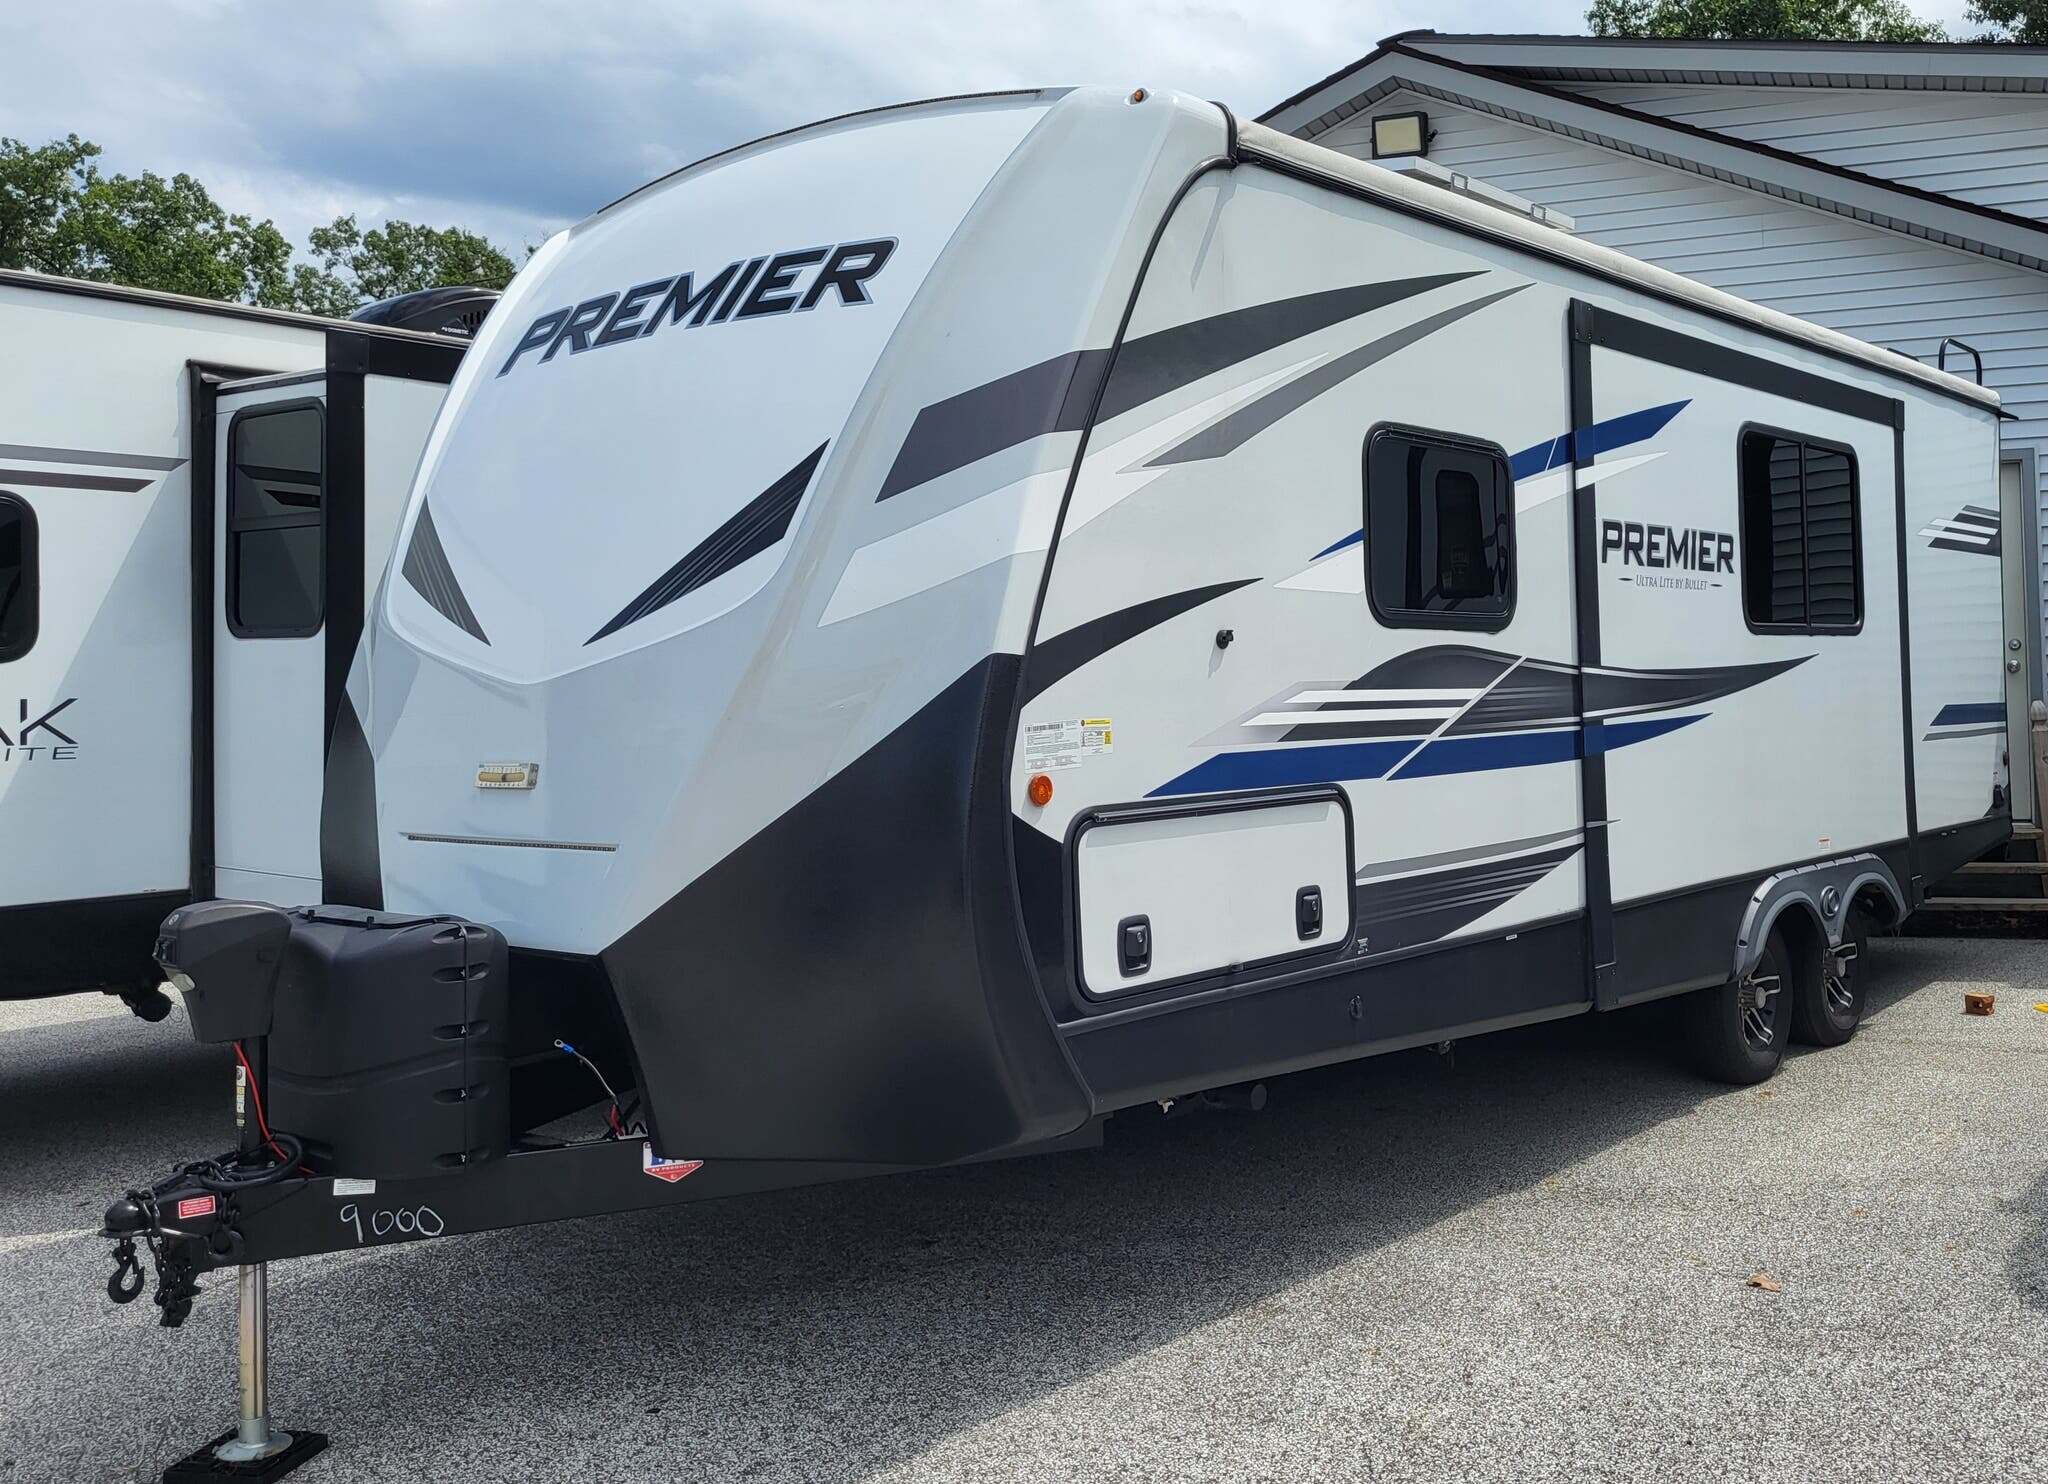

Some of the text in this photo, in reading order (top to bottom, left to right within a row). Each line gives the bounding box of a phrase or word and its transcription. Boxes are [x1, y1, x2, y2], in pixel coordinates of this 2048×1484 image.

[495, 235, 899, 379] PREMIER
[1601, 518, 1734, 574] PREMIER
[1635, 574, 1658, 587] ULTRA
[1659, 576, 1675, 588] LITE
[1685, 579, 1708, 590] BULLET
[0, 698, 79, 746] K
[340, 1203, 445, 1244] 9000
